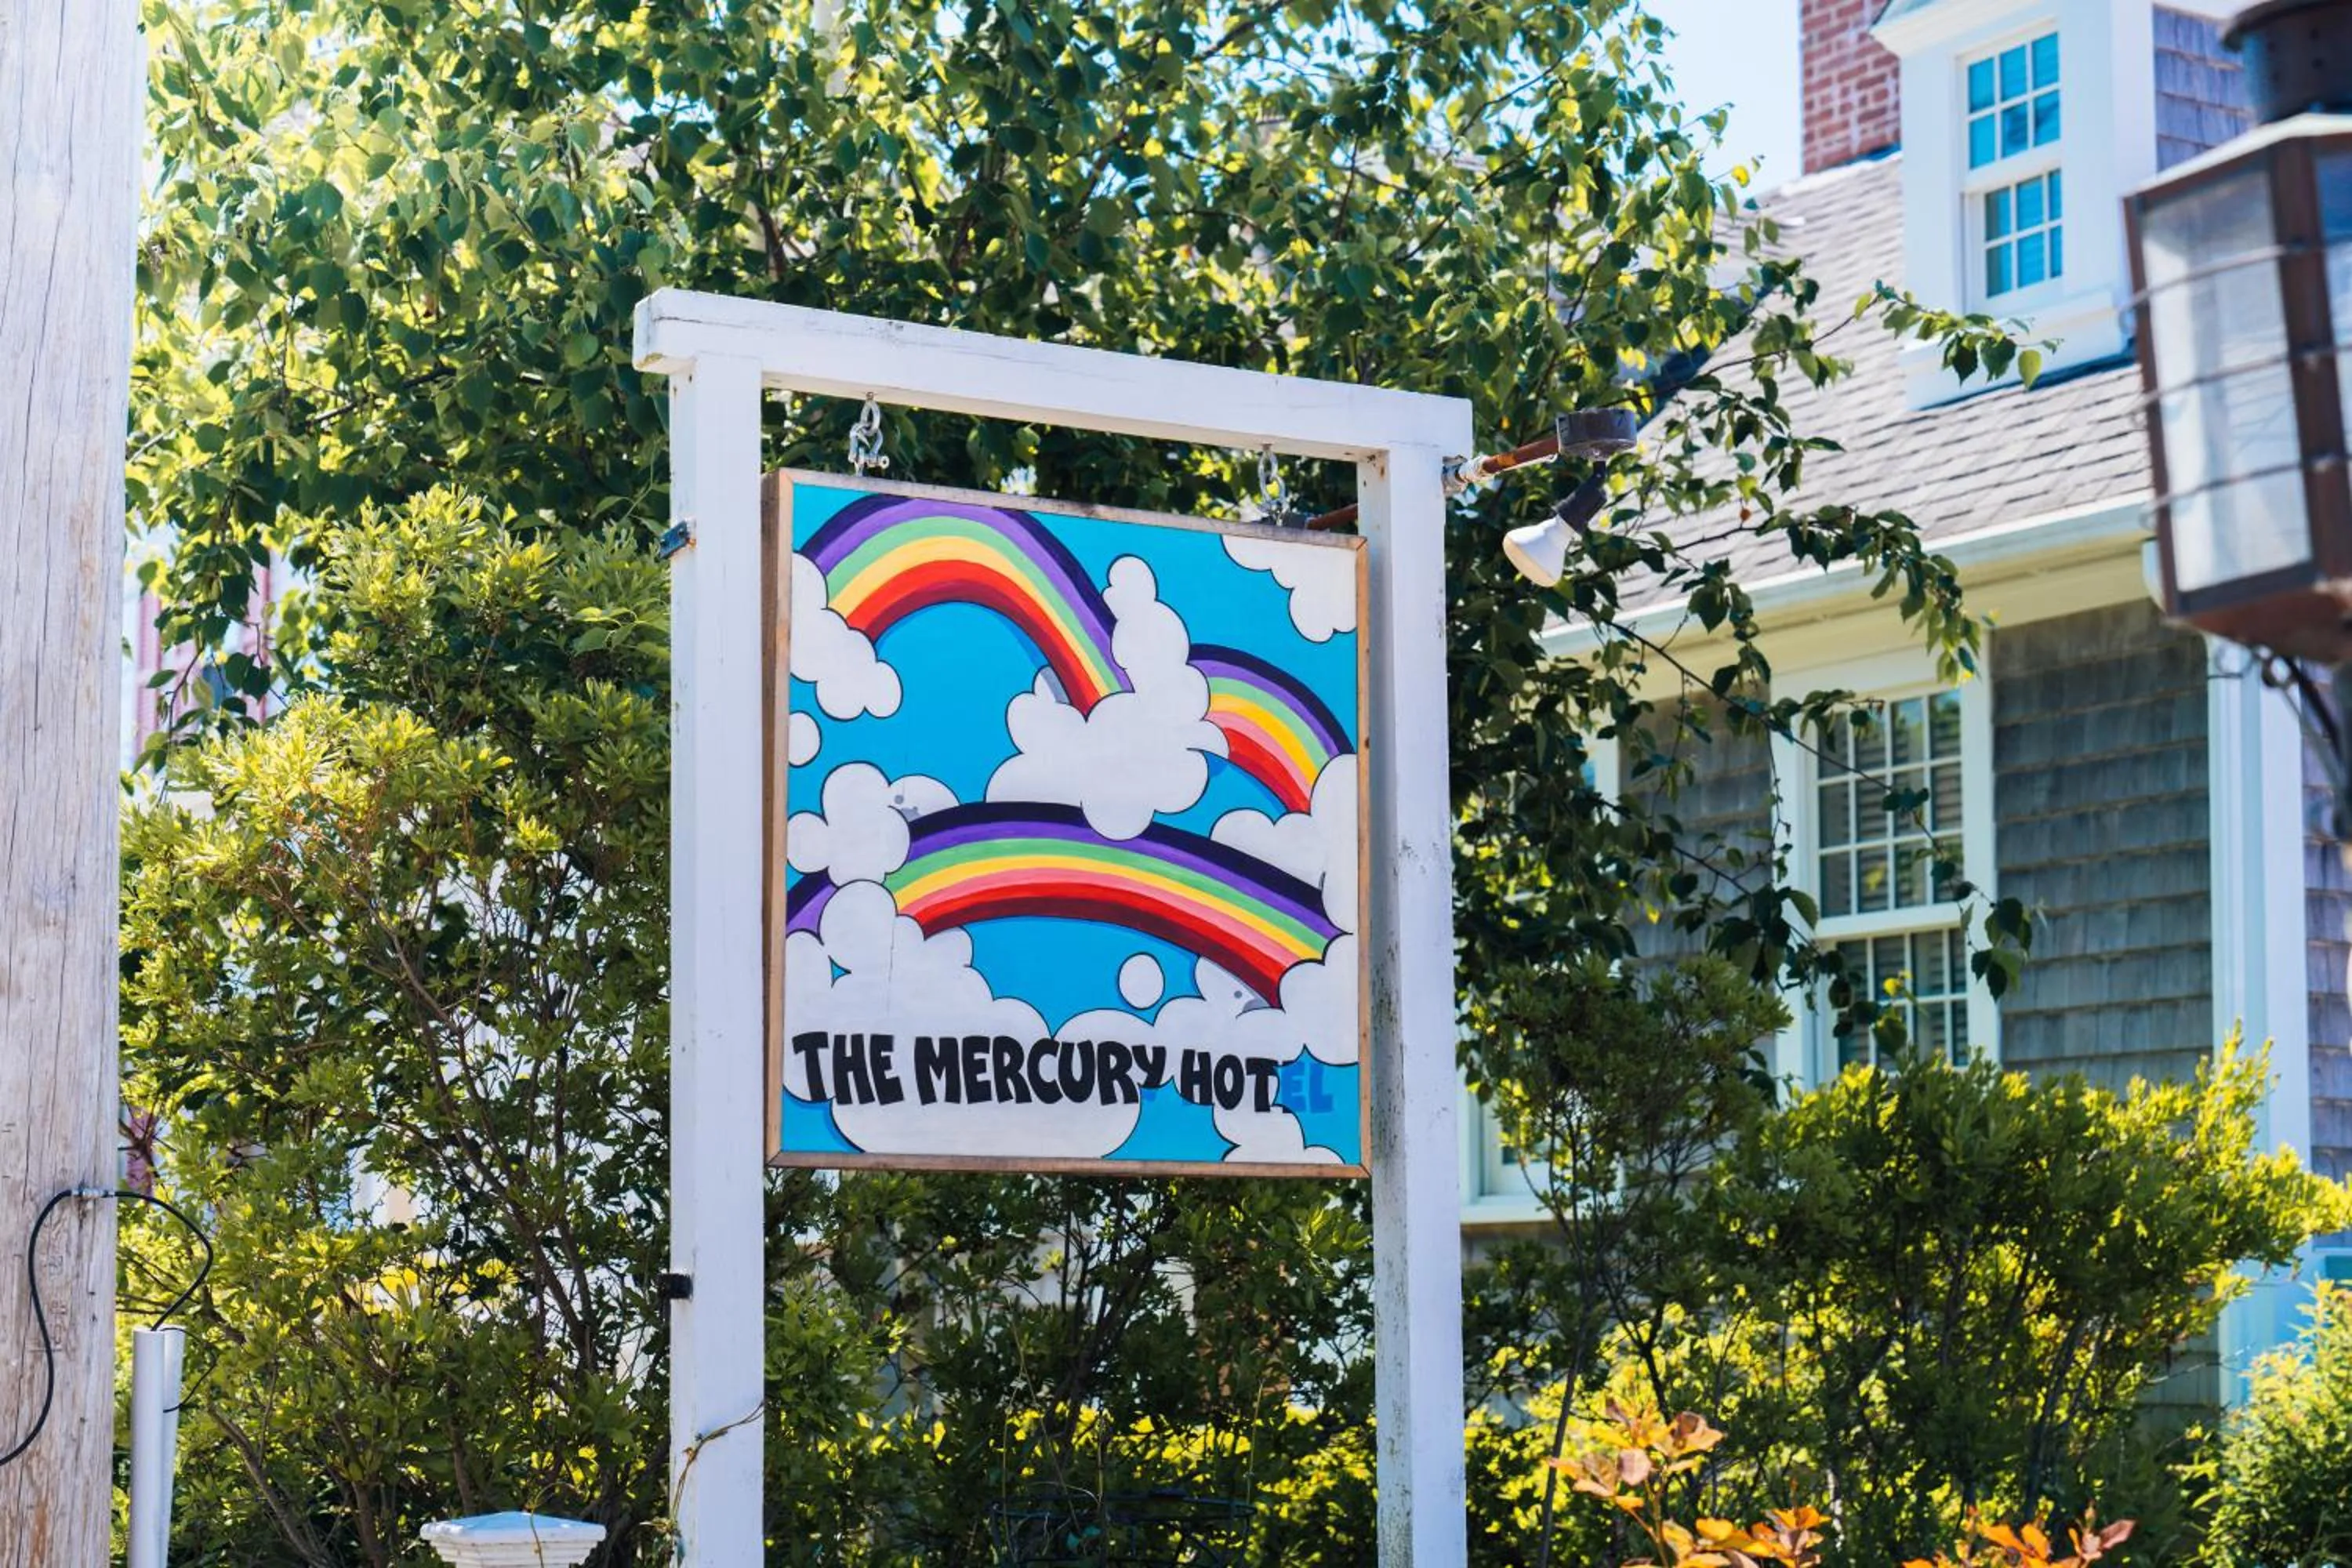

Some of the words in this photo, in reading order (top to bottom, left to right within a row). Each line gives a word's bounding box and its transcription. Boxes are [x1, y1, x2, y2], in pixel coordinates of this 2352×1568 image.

[792, 1032, 904, 1105] THE
[914, 1035, 1167, 1105] MERCURY
[1180, 1049, 1334, 1114] HOTEL
